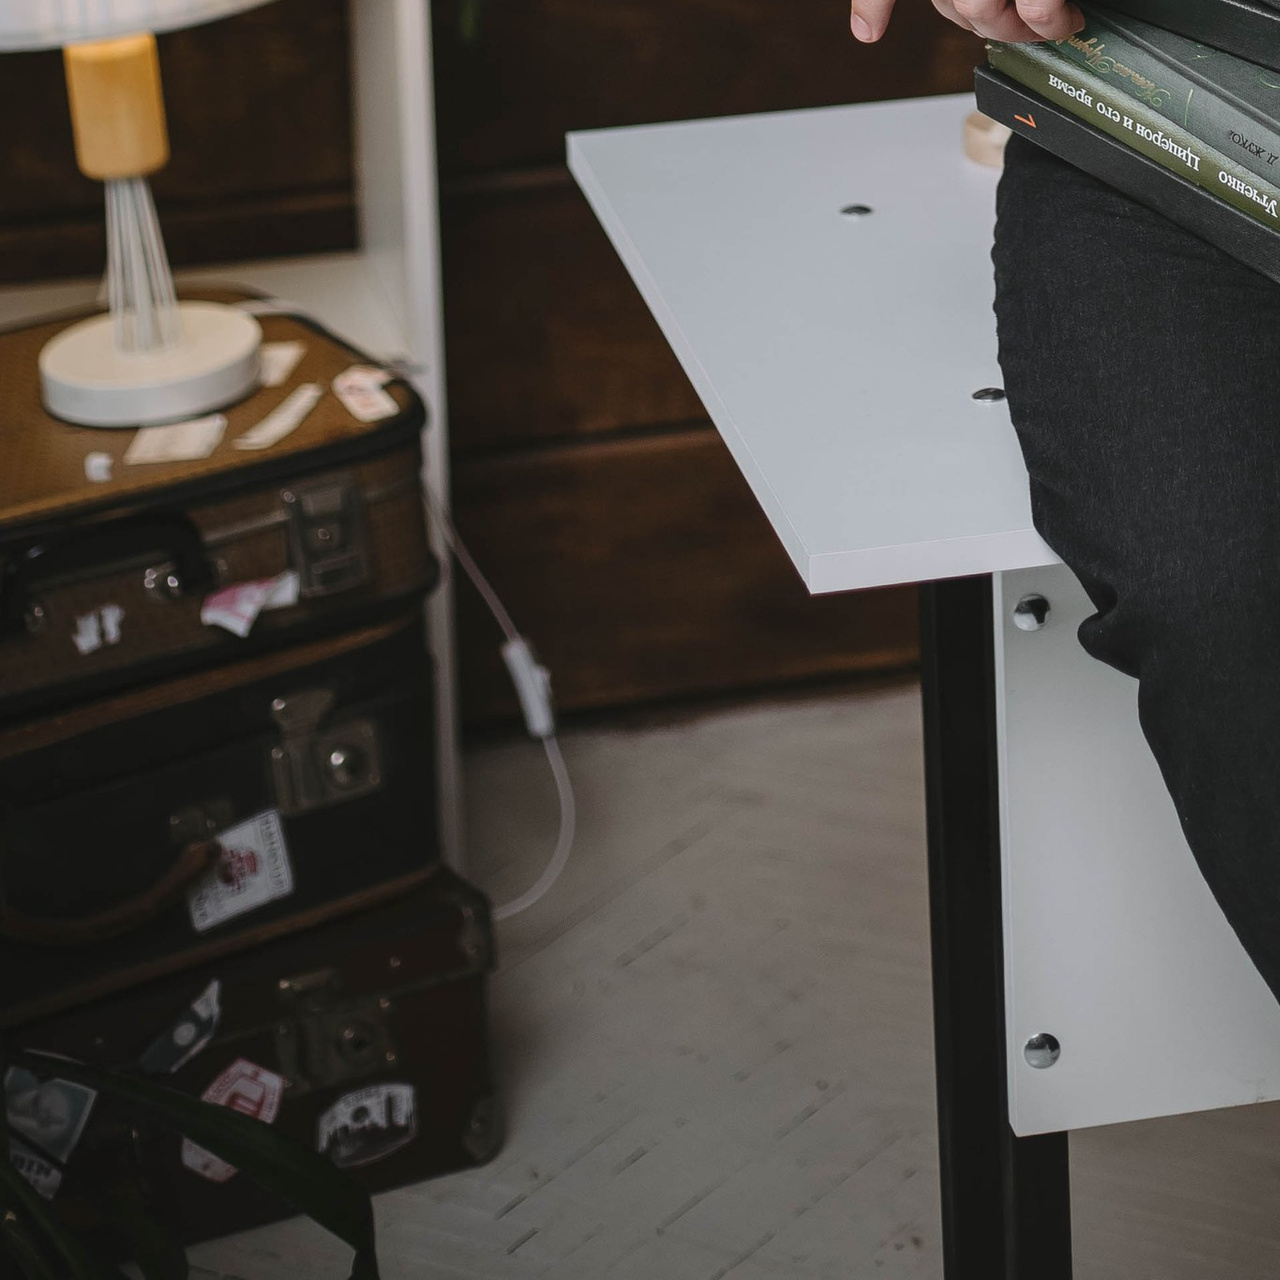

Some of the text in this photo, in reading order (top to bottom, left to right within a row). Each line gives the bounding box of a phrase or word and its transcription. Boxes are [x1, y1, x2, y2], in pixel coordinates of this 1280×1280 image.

[1048, 74, 1093, 108] время
[1096, 101, 1121, 123] его
[1123, 115, 1134, 131] и
[1136, 123, 1201, 172] Цицерон
[1218, 170, 1279, 218] Утченко
